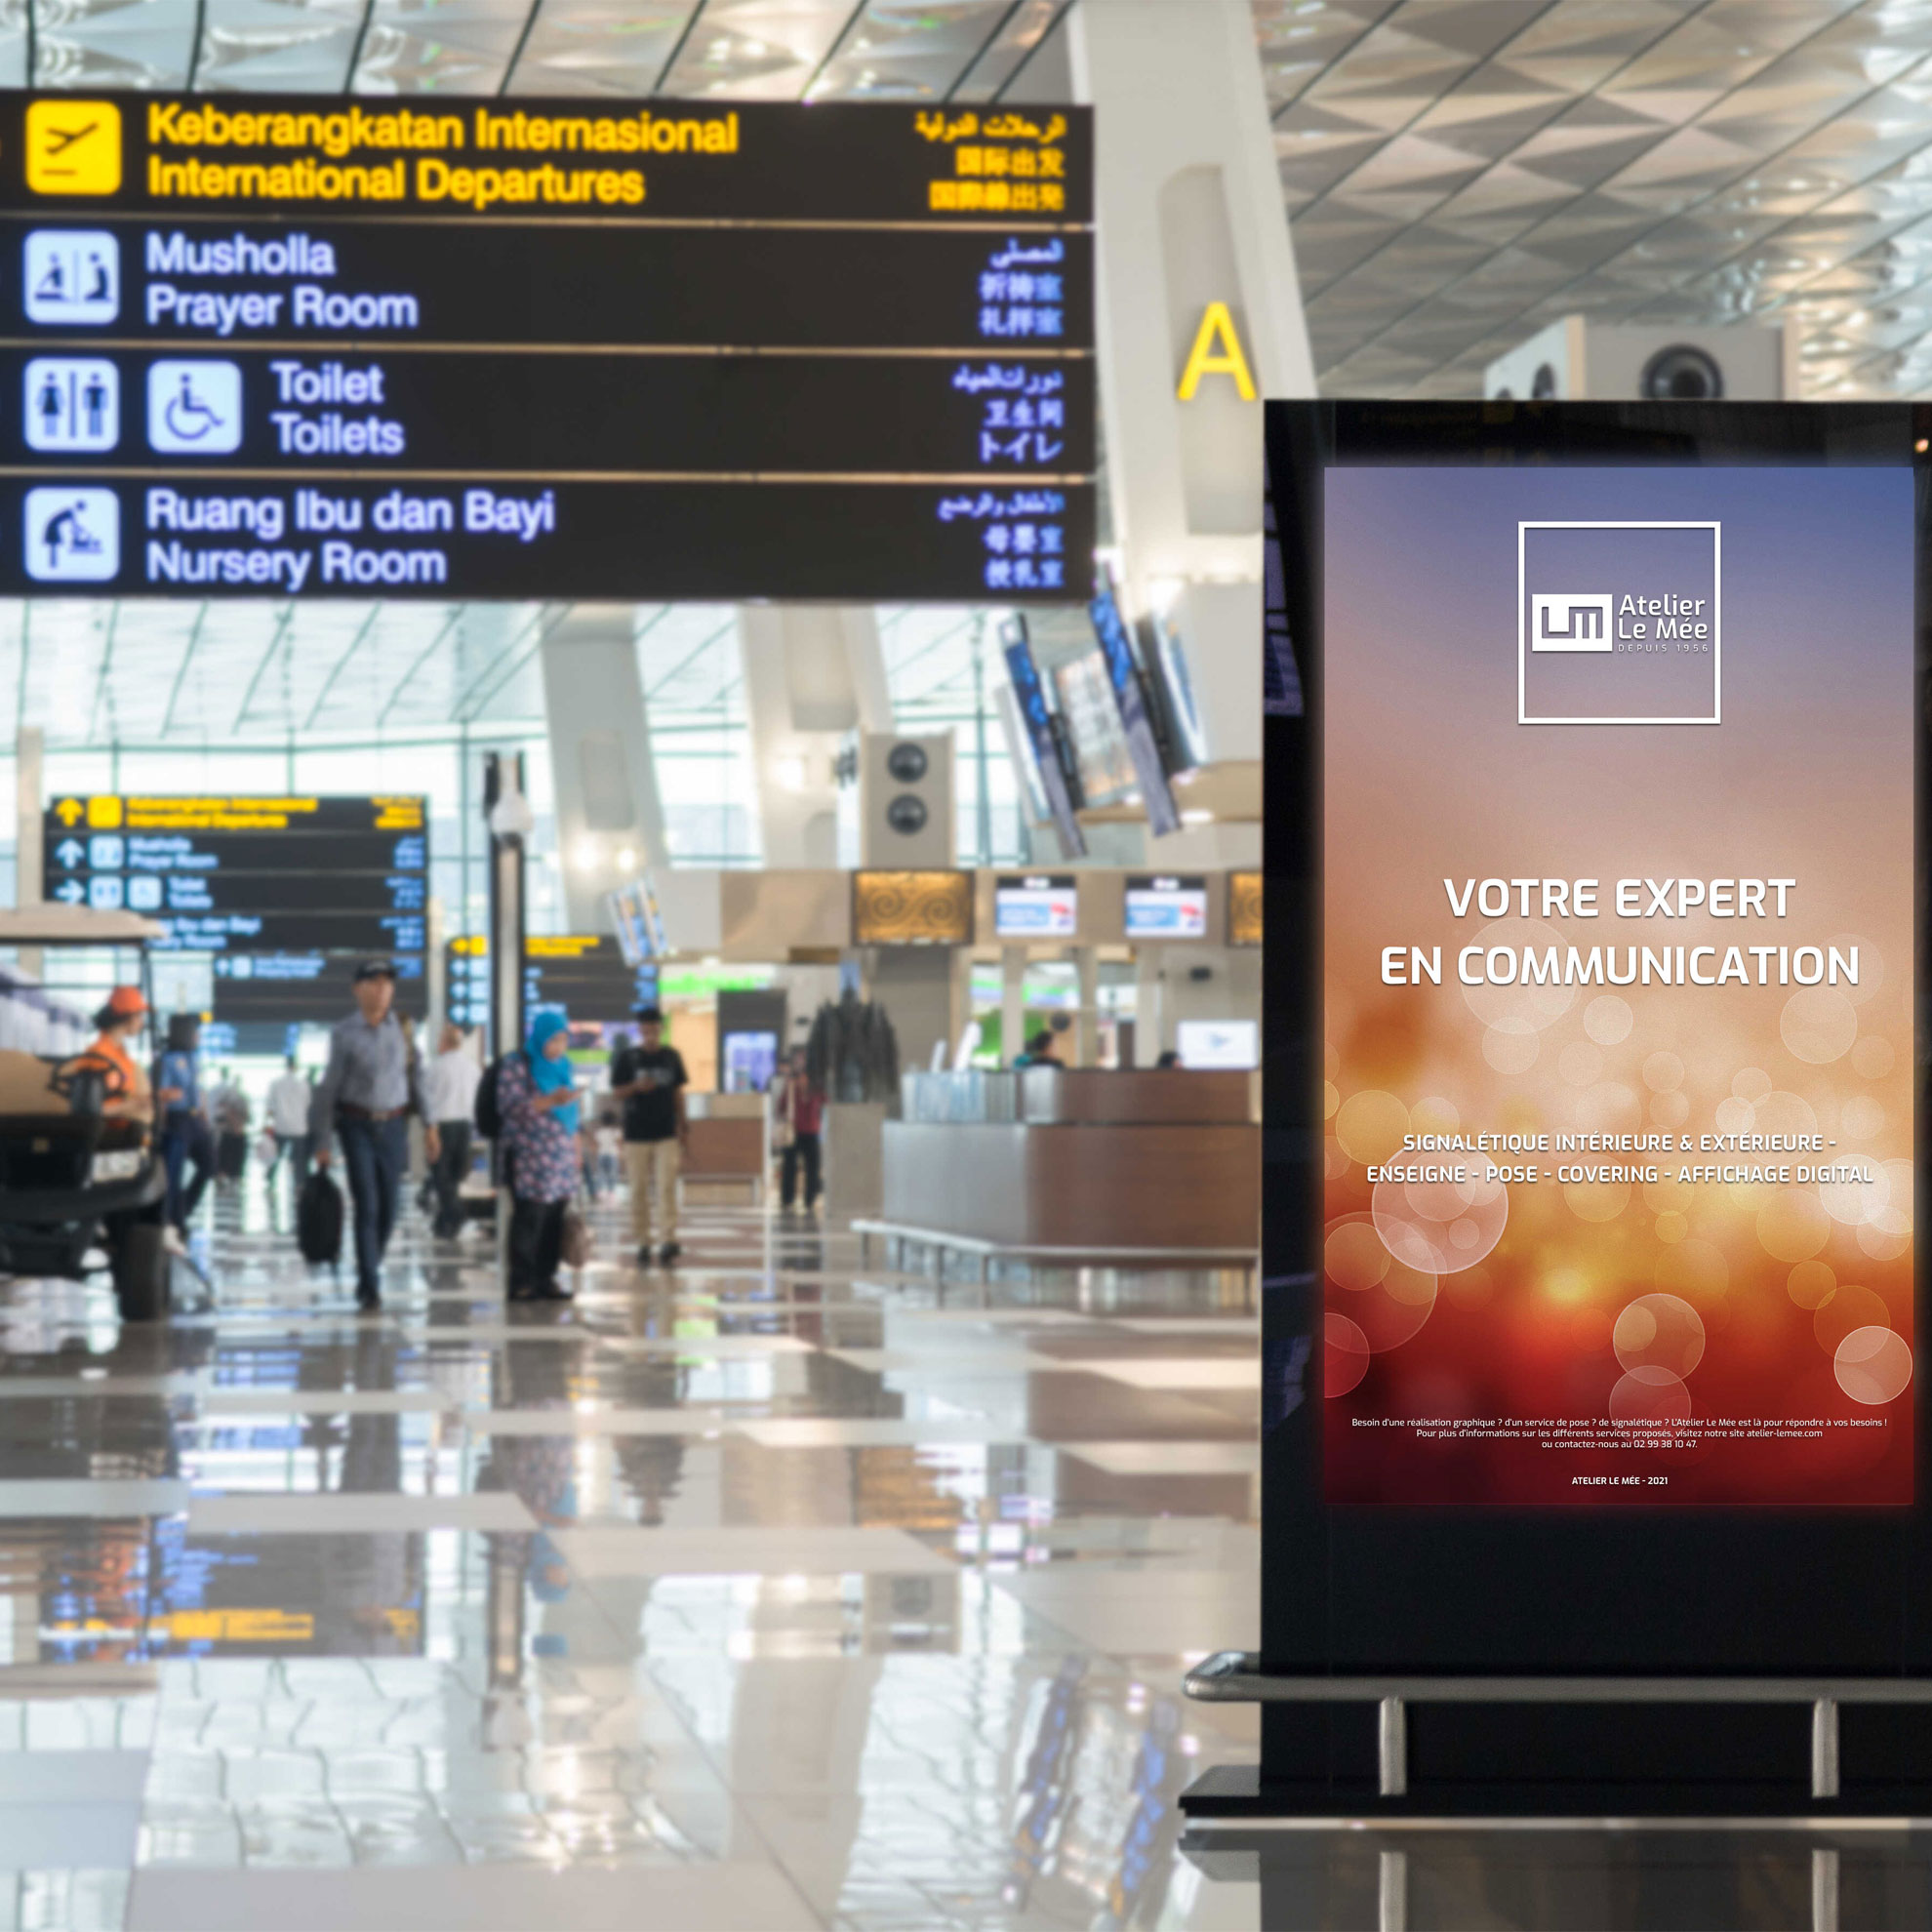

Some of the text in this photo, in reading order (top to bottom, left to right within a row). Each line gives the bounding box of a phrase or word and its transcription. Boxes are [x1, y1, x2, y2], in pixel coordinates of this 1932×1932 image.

[147, 103, 739, 156] Keberangkatan Internasional
[147, 155, 645, 210] International Departures
[145, 231, 337, 276] Musholla
[145, 284, 419, 337] Prayer Room
[1178, 301, 1257, 401] A
[269, 361, 384, 404] Toilet
[269, 412, 405, 456] Toilets
[979, 430, 1064, 463] トイレ
[145, 489, 555, 543] Ruang Ibu dan Bayi
[145, 541, 447, 593] Nursery Room
[1618, 593, 1706, 616] Atelier
[1618, 618, 1708, 639] Le Mée
[1618, 643, 1709, 652] DEPUIS 1956
[1444, 878, 1796, 917] VOTRE EXPERT
[1381, 946, 1859, 986] EN COMMUNICATION
[1402, 1130, 1550, 1154] SIGNALÉTIQUE
[1555, 1130, 1673, 1150] INTÉRIEURE
[1679, 1134, 1694, 1150] &
[1700, 1130, 1824, 1150] EXTÉRIEURE
[1366, 1165, 1467, 1183] ENSEIGNE
[1485, 1165, 1538, 1183] POSE
[1557, 1165, 1658, 1183] COVERING
[1677, 1165, 1791, 1183] AFFICHAGE
[1796, 1165, 1873, 1183] DIGITAL
[1351, 1418, 1381, 1427] Besoin
[1382, 1418, 1405, 1427] d'une
[1407, 1418, 1452, 1427] réalisation
[1453, 1418, 1496, 1429] graphique
[1505, 1418, 1523, 1427] d'un
[1524, 1418, 1555, 1427] service
[1556, 1418, 1568, 1427] de
[1569, 1420, 1590, 1429] pose
[1598, 1418, 1609, 1427] de
[1611, 1418, 1663, 1429] signalétique
[1670, 1418, 1705, 1427] L'Atelier
[1706, 1418, 1717, 1427] Le
[1718, 1418, 1737, 1427] Mée
[1752, 1418, 1762, 1427] là
[1763, 1420, 1784, 1429] pour
[1785, 1418, 1825, 1429] répondre
[1826, 1418, 1832, 1427] à
[1850, 1418, 1883, 1427] besoins
[1416, 1429, 1437, 1437] Pour
[1438, 1429, 1457, 1439] plus
[1459, 1429, 1520, 1437] d'informations
[1538, 1429, 1551, 1437] les
[1552, 1429, 1594, 1437] différents
[1595, 1429, 1631, 1437] services
[1632, 1429, 1673, 1439] proposés,
[1674, 1429, 1703, 1437] visitez
[1704, 1429, 1728, 1437] notre
[1729, 1429, 1745, 1437] site
[1746, 1429, 1823, 1437] atelier-lemee.com
[1571, 1476, 1607, 1485] ATELIER
[1608, 1476, 1620, 1485] LE
[1621, 1474, 1640, 1485] MÉE
[1647, 1476, 1669, 1485] 2021
